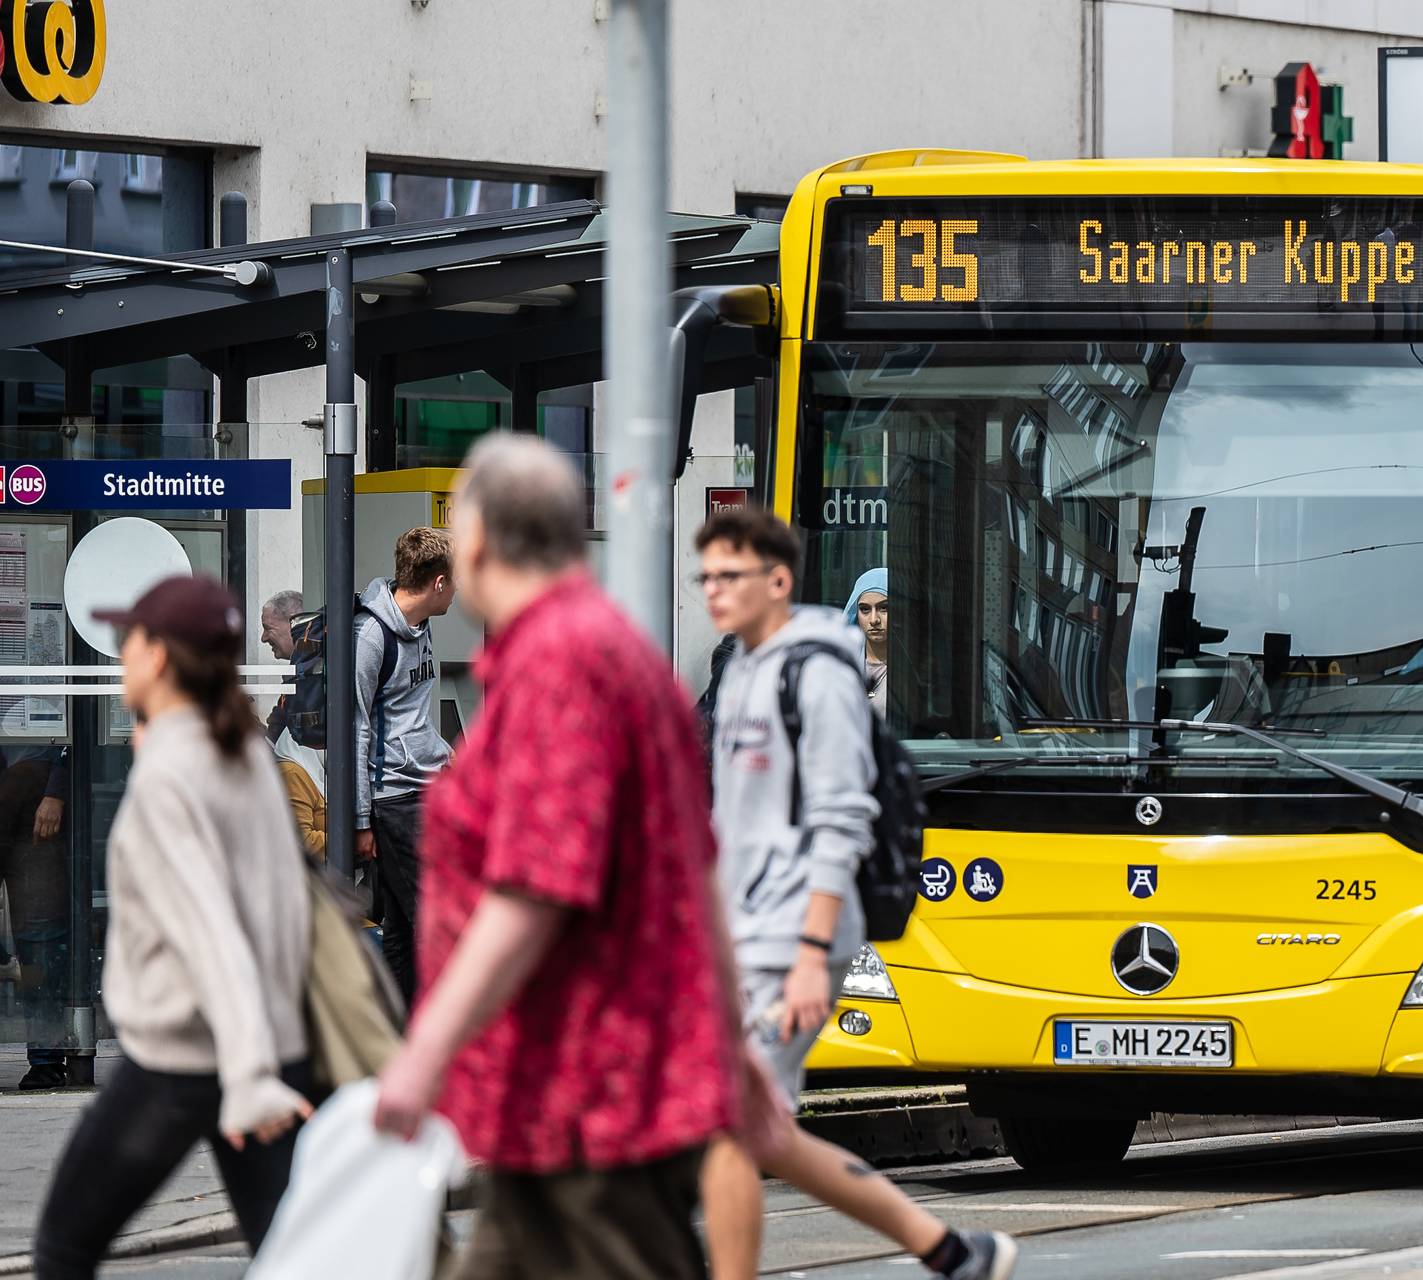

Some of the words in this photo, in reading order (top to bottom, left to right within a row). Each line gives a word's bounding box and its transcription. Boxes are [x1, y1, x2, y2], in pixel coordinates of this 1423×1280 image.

[868, 220, 978, 302] 135
[1079, 220, 1256, 284] Saarner
[1284, 220, 1415, 303] Kuppe
[11, 477, 44, 493] BUS
[103, 471, 225, 496] Stadtmitte
[1316, 879, 1376, 900] 2245
[1256, 933, 1341, 945] CITARO
[1075, 1028, 1092, 1055] E
[1113, 1029, 1149, 1056] MH
[1156, 1029, 1227, 1056] 2245
